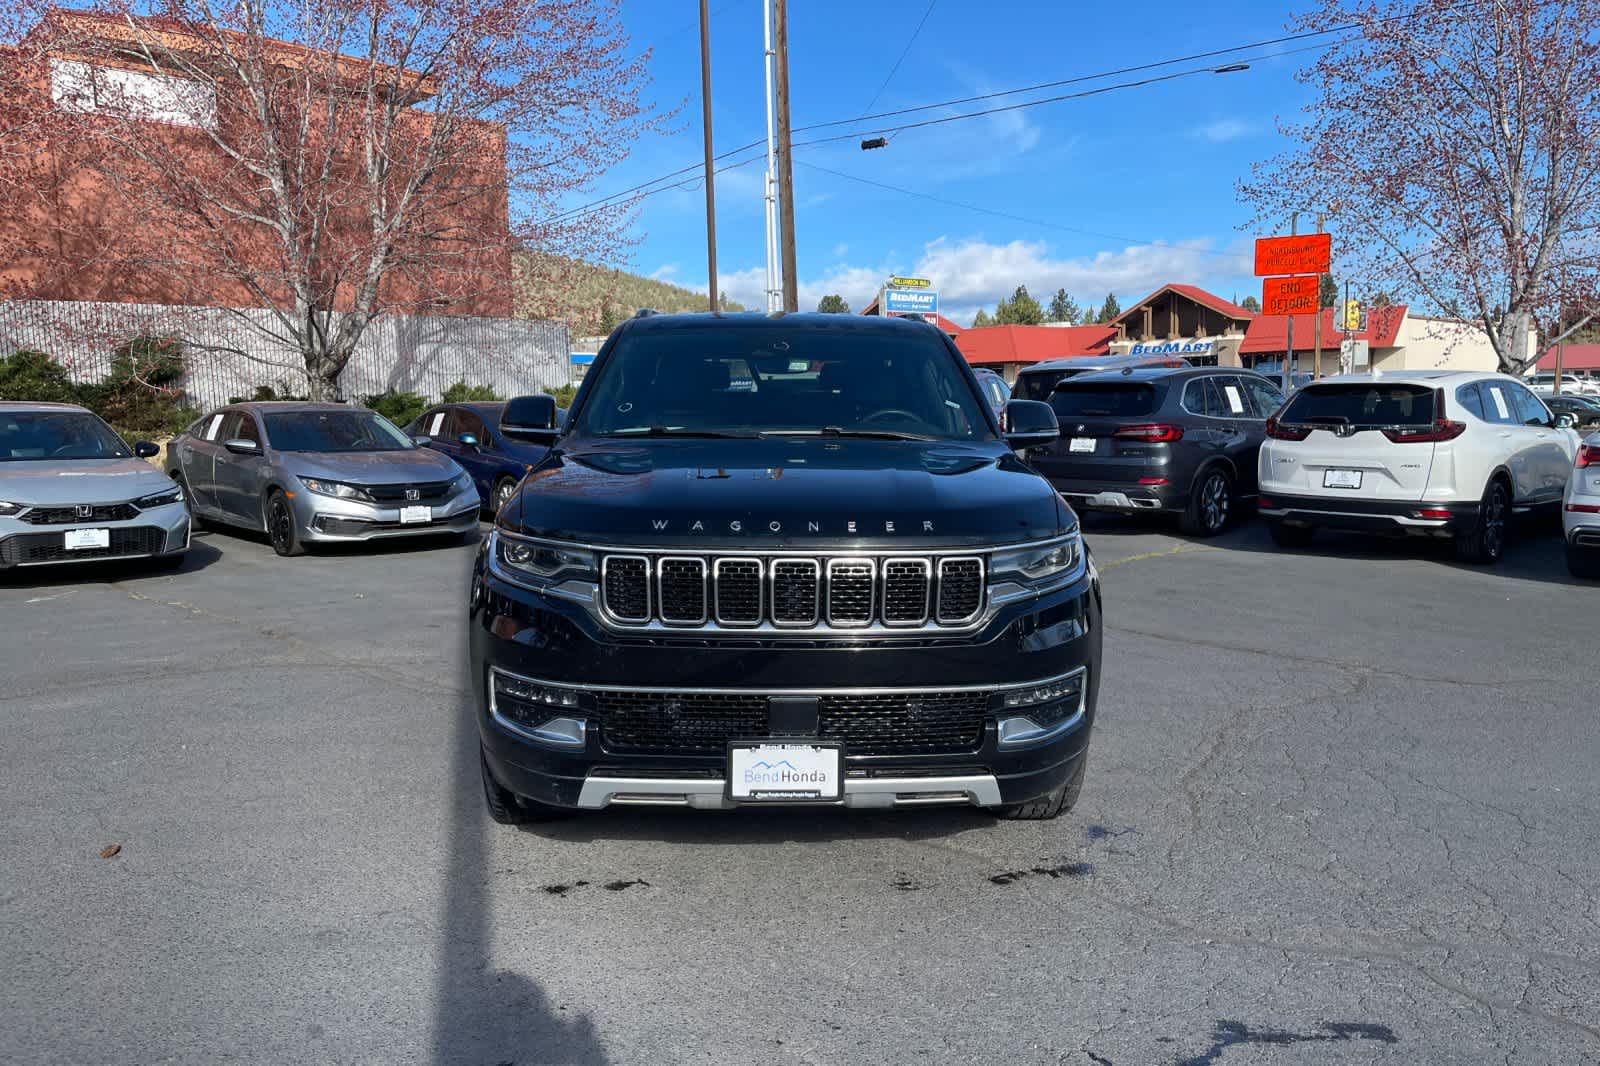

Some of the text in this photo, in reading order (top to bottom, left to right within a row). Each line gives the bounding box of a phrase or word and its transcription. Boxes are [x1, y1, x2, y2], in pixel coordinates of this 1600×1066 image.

[1280, 282, 1301, 294] END
[1270, 296, 1313, 310] DETOUR
[651, 519, 935, 533] WAGONEER
[744, 769, 827, 783] Bend Honda
